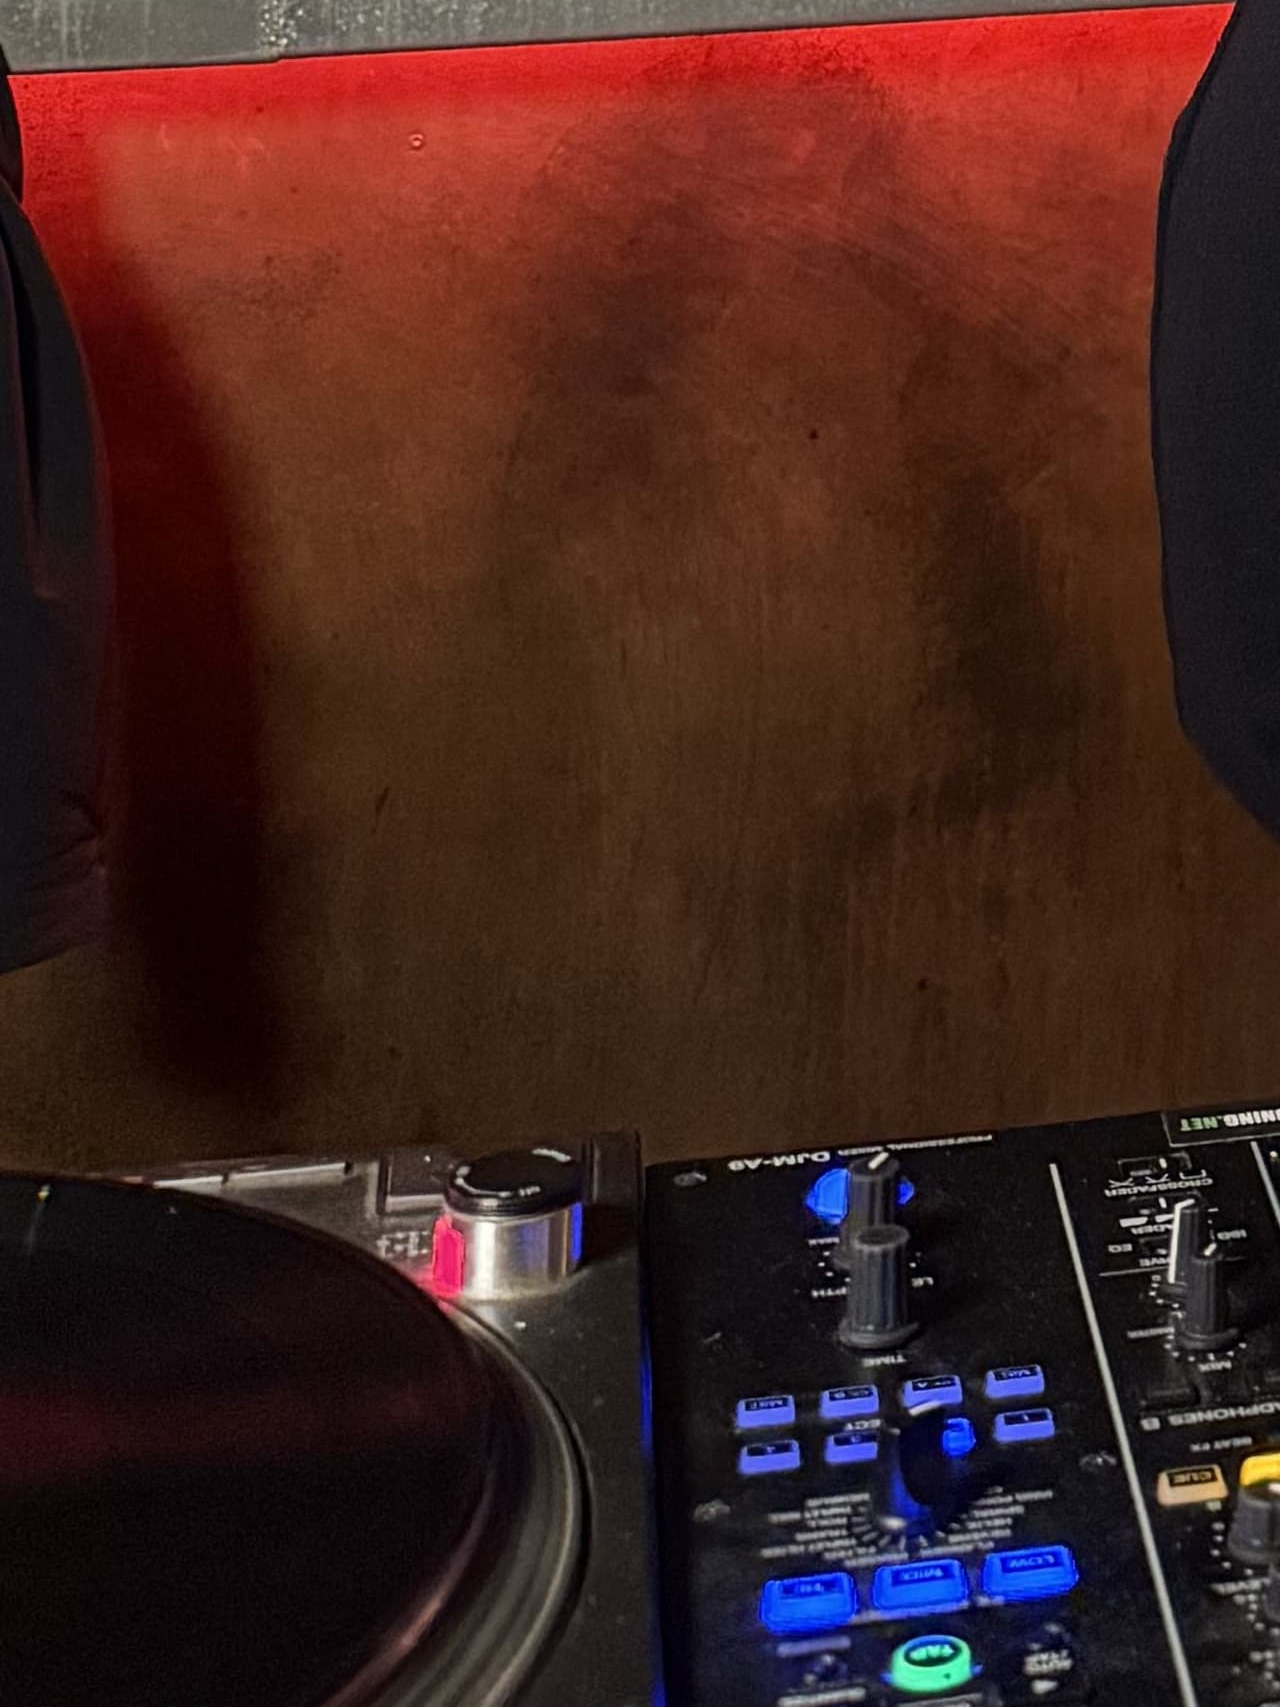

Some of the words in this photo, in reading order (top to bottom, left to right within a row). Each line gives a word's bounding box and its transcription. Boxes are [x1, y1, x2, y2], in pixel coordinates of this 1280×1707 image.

[727, 1150, 831, 1171] DJM-A9
[861, 1354, 907, 1367] TIME
[1171, 1470, 1212, 1484] CUE
